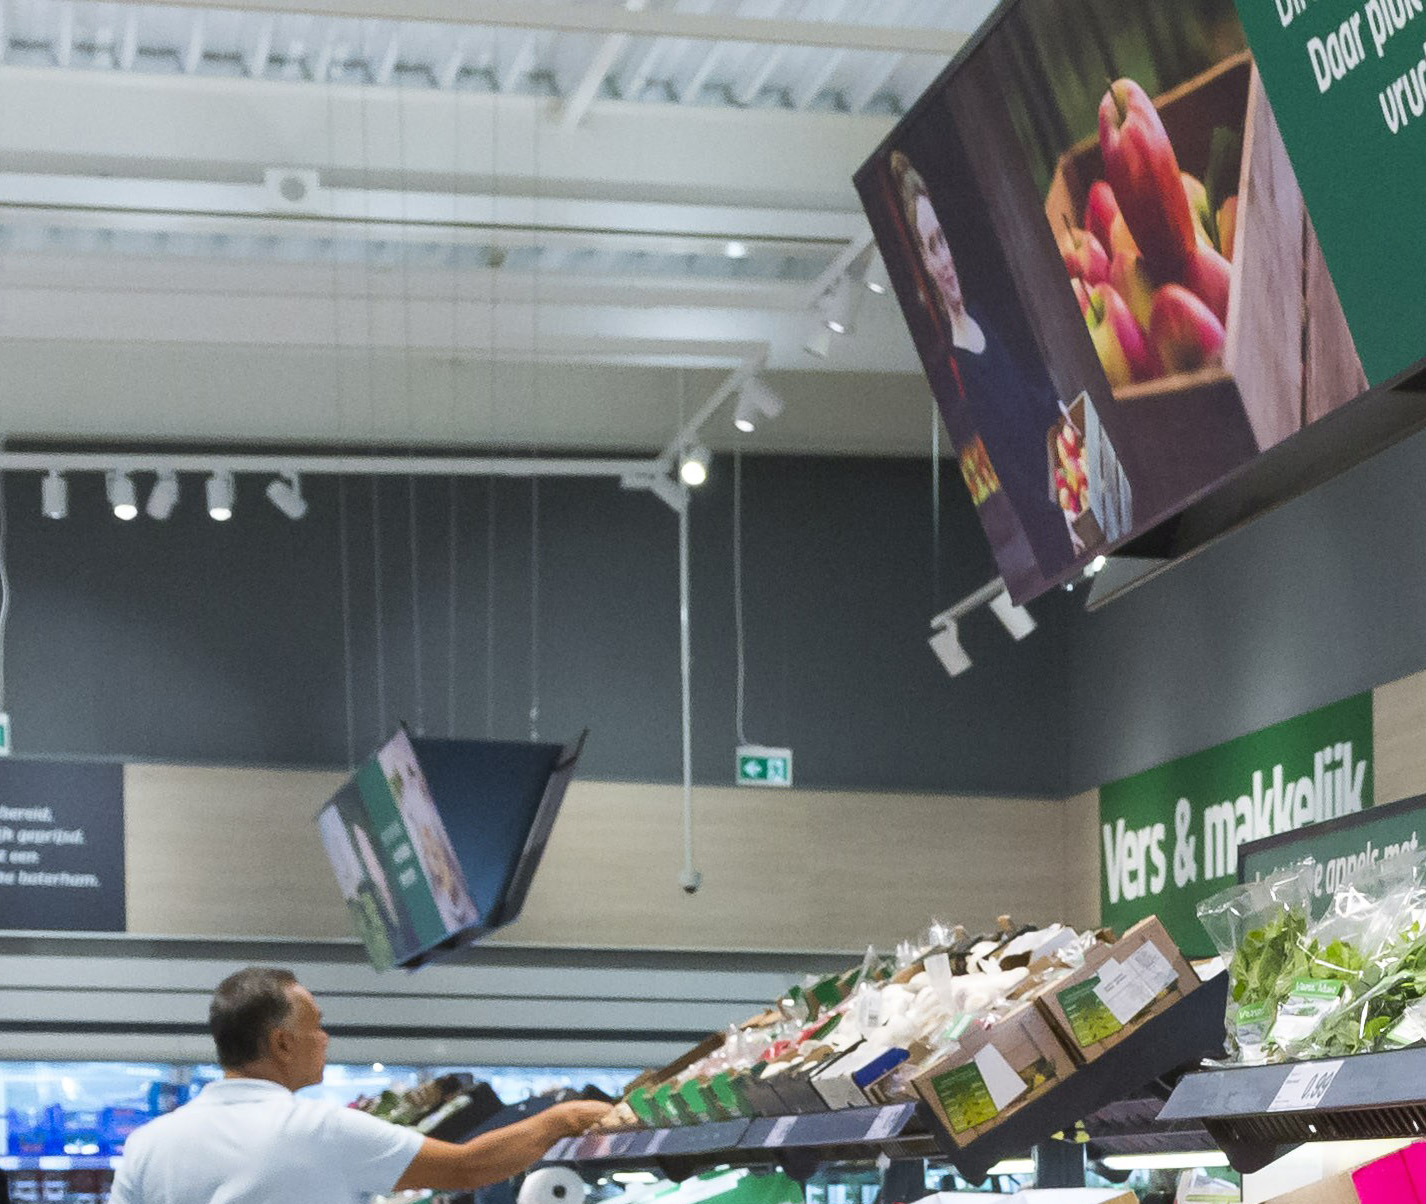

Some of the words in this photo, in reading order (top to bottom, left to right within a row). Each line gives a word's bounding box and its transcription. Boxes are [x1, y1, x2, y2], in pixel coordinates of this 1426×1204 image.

[1307, 11, 1366, 93] Daar
[1103, 818, 1167, 904] Vers
[1172, 798, 1198, 888] &
[1203, 741, 1367, 881] makkelijk
